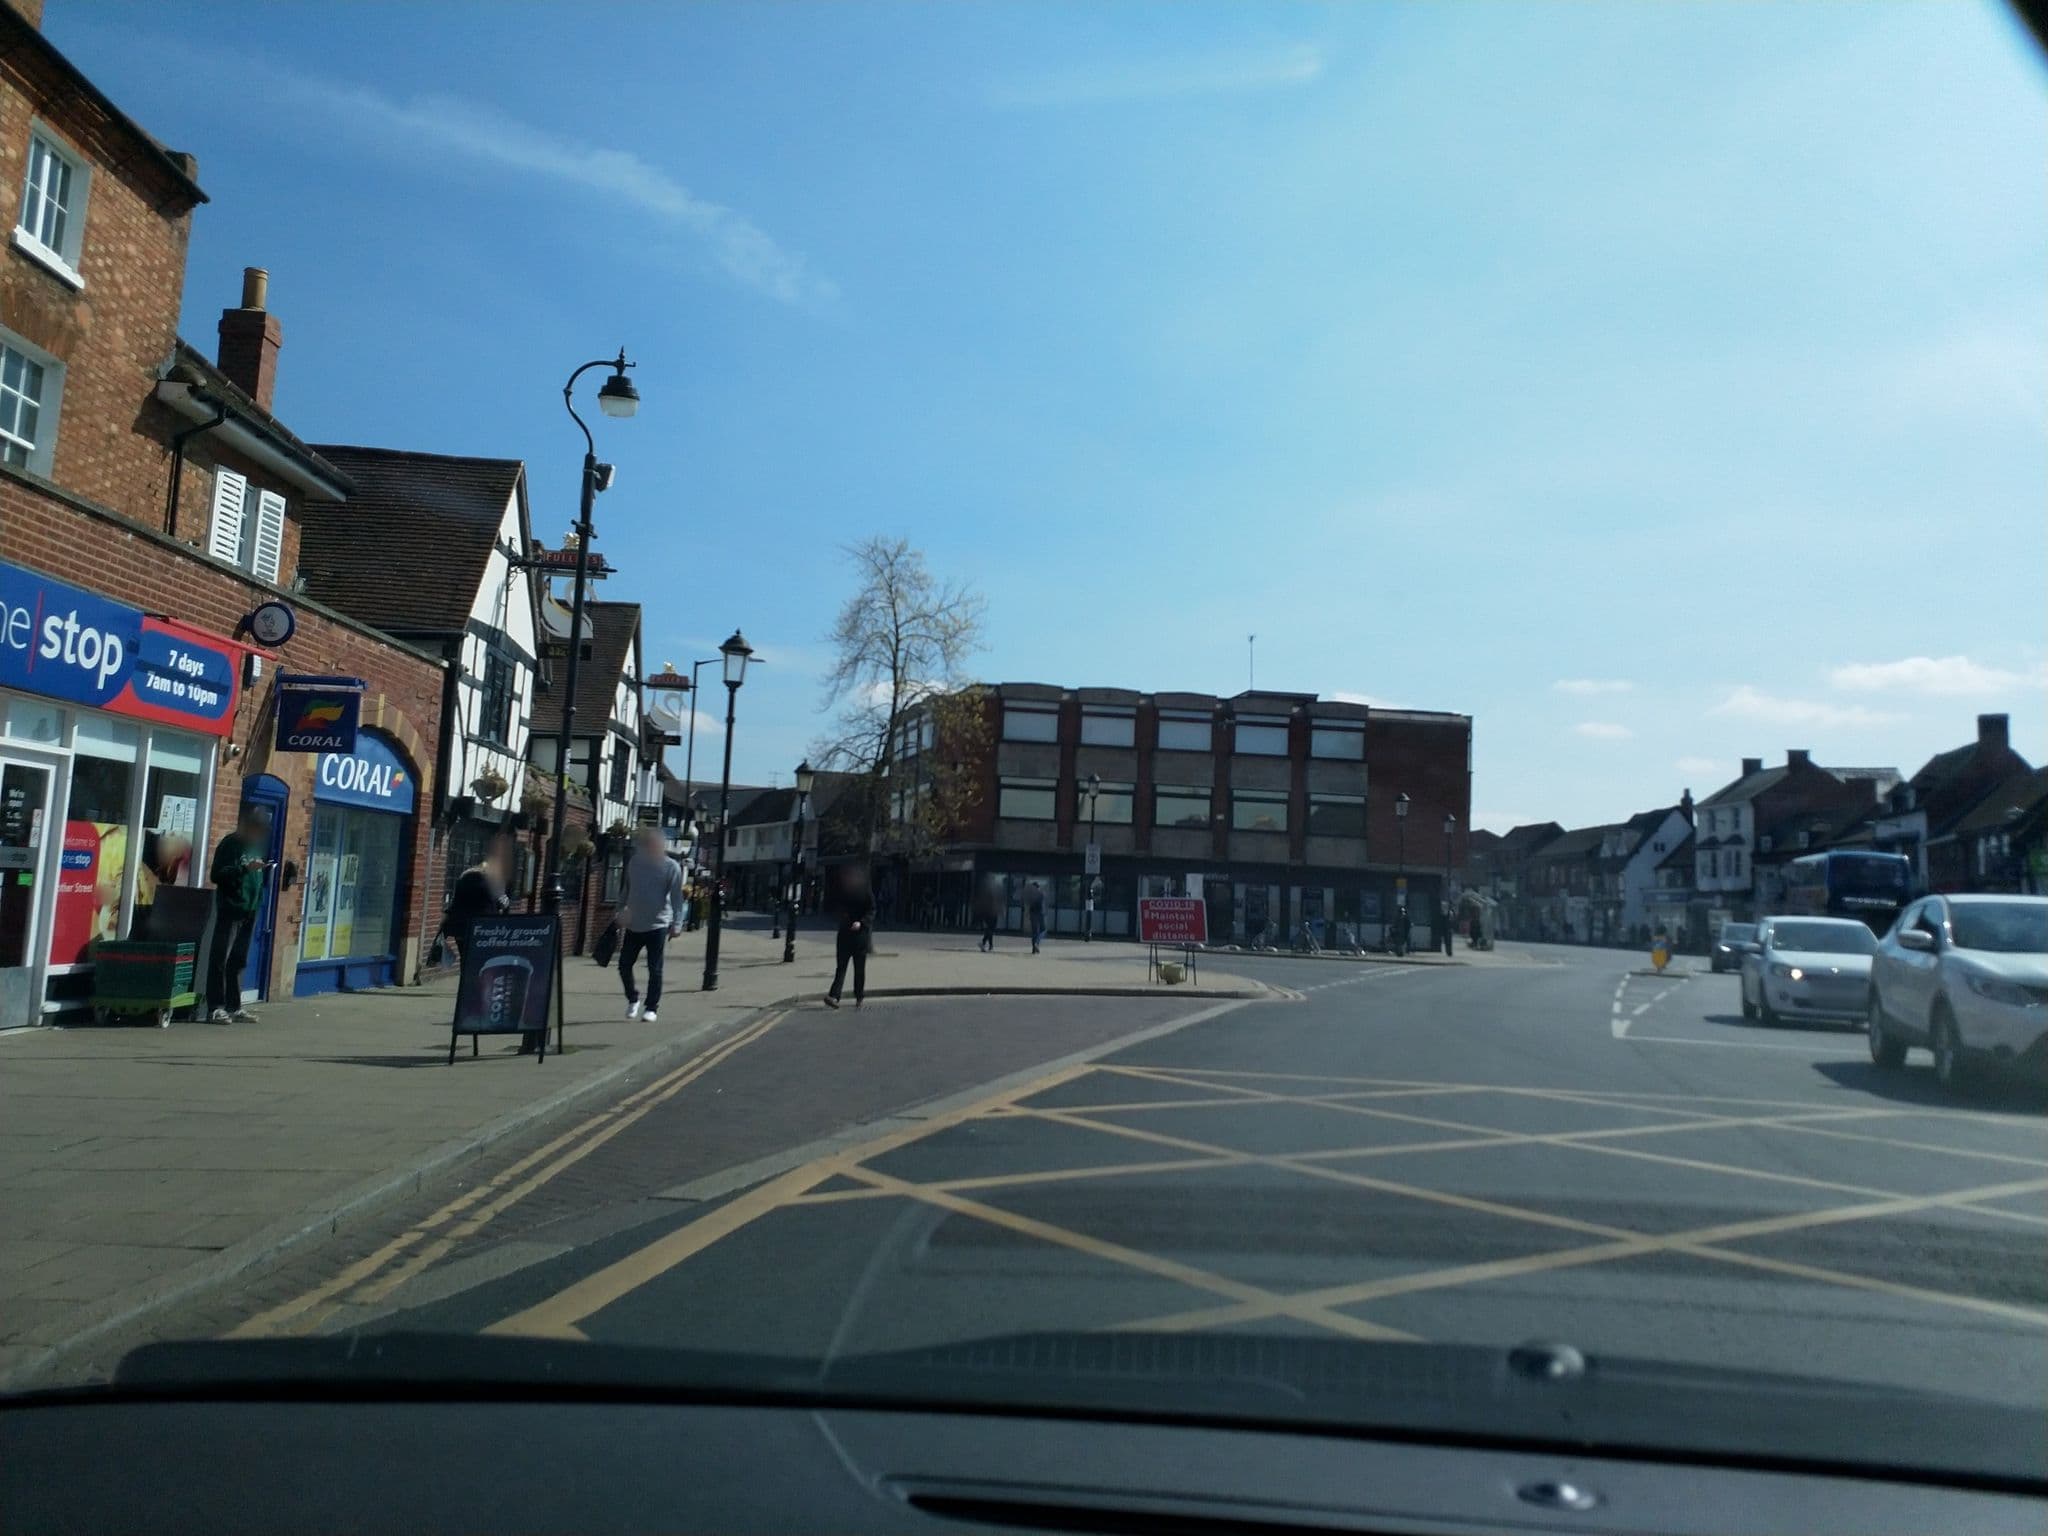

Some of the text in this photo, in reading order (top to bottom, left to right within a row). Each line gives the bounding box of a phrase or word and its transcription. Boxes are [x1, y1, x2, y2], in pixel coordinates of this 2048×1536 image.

[40, 610, 123, 690] stop
[168, 650, 204, 676] 7 days
[146, 672, 218, 706] 7am to 10pm
[287, 735, 343, 747] CORAL
[322, 753, 392, 797] CORAL
[1149, 900, 1195, 909] COVID-19
[1150, 910, 1195, 920] Maintain
[473, 925, 550, 939] Freshly ground
[1158, 921, 1188, 931] social
[476, 937, 508, 947] coffee
[1152, 931, 1196, 941] distance
[490, 976, 504, 1022] COSTA
